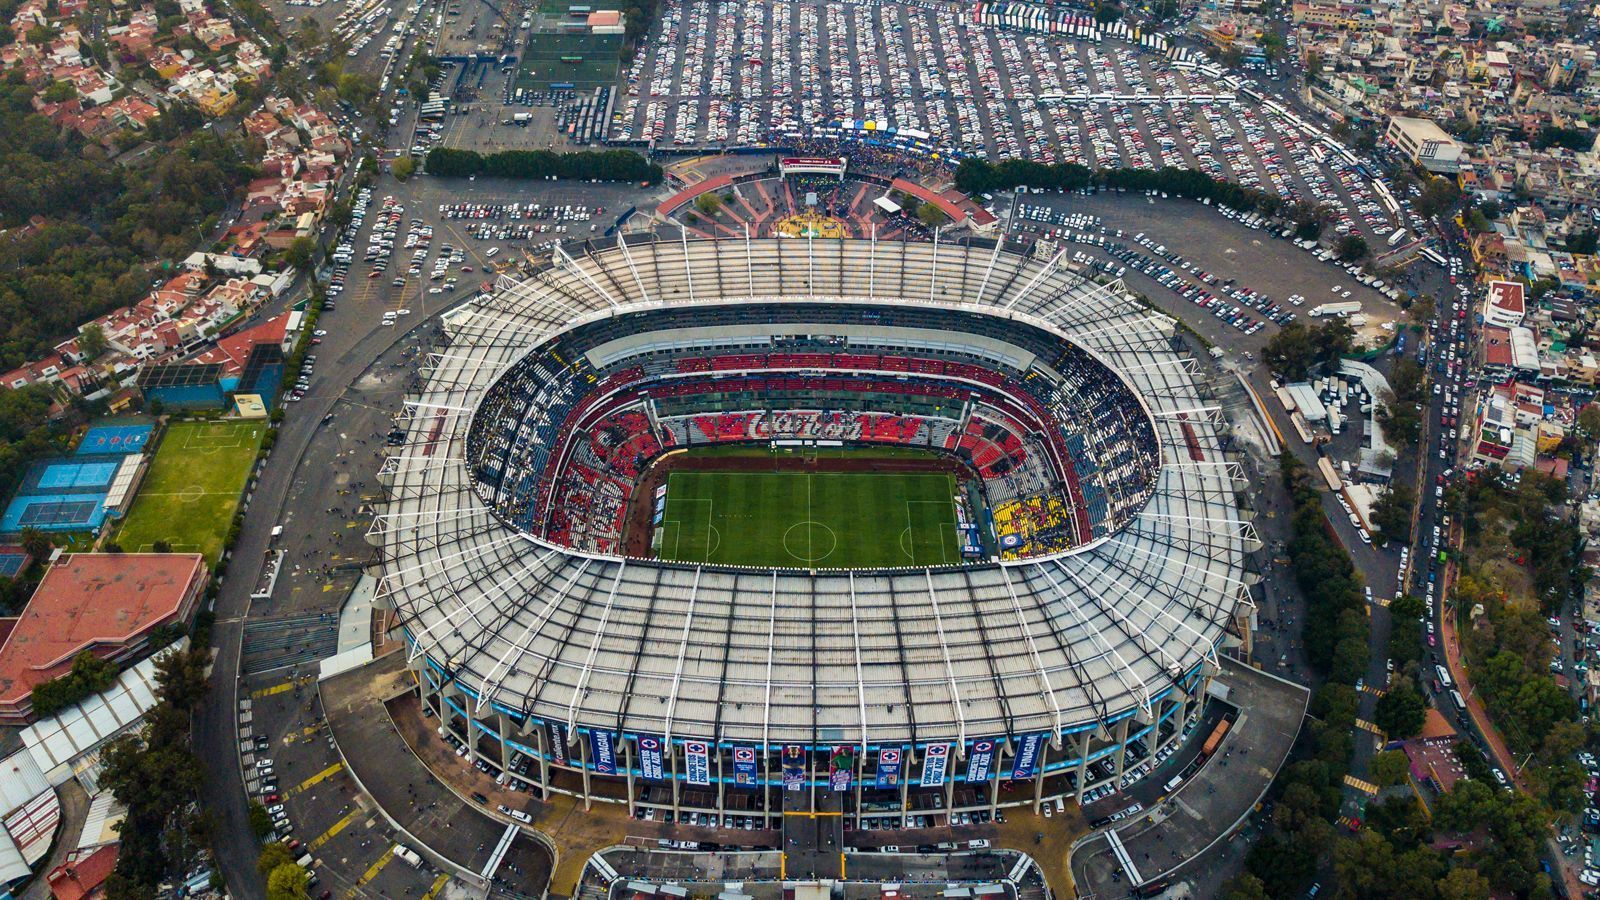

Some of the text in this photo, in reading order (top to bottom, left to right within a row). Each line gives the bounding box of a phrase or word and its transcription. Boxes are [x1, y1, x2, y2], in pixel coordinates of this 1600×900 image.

[551, 724, 563, 760] caliente.mx
[596, 731, 611, 764] FINAGAM
[1020, 735, 1039, 768] FINAGAM
[641, 750, 652, 778] CONCRETOS
[650, 751, 662, 779] CRUZ AZUL
[687, 754, 697, 782] CONCRETOS
[697, 755, 707, 783] CRUZ AZUL
[923, 757, 935, 784] CONCRETOS
[932, 757, 945, 784] CRUZ AZUL
[967, 753, 980, 782] CONCRETOS
[976, 753, 991, 781] CRUZ AZUL
